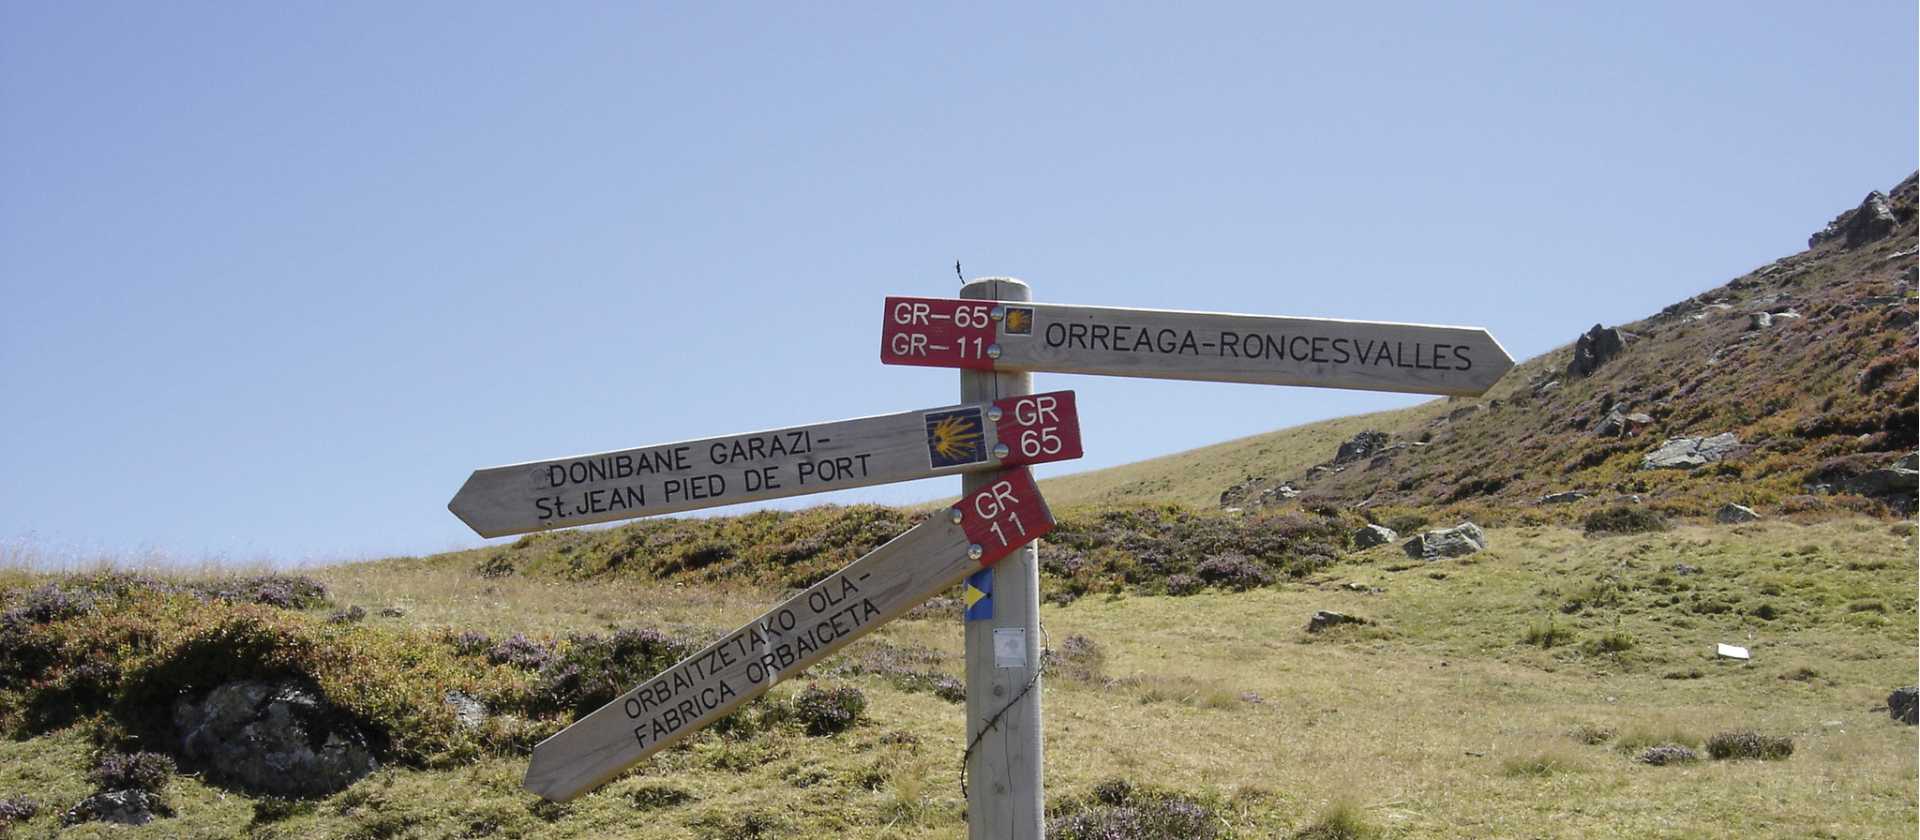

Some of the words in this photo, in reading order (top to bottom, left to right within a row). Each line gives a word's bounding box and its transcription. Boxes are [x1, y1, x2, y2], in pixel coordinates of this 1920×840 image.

[893, 303, 989, 329] GR-65
[1045, 322, 1473, 371] ORREAGA-RONCESVALLES
[1015, 395, 1059, 426] GR
[1021, 427, 1062, 457] 65
[550, 446, 691, 488] DONIBANE
[665, 473, 726, 505] PIED
[746, 468, 780, 492] DE
[799, 453, 871, 485] PORT
[974, 480, 1020, 521] GR
[989, 511, 1029, 547] 11
[624, 608, 797, 720] ORBAITZETAKO
[634, 680, 736, 749] FABRICA
[746, 598, 880, 686] ORBAICETA
